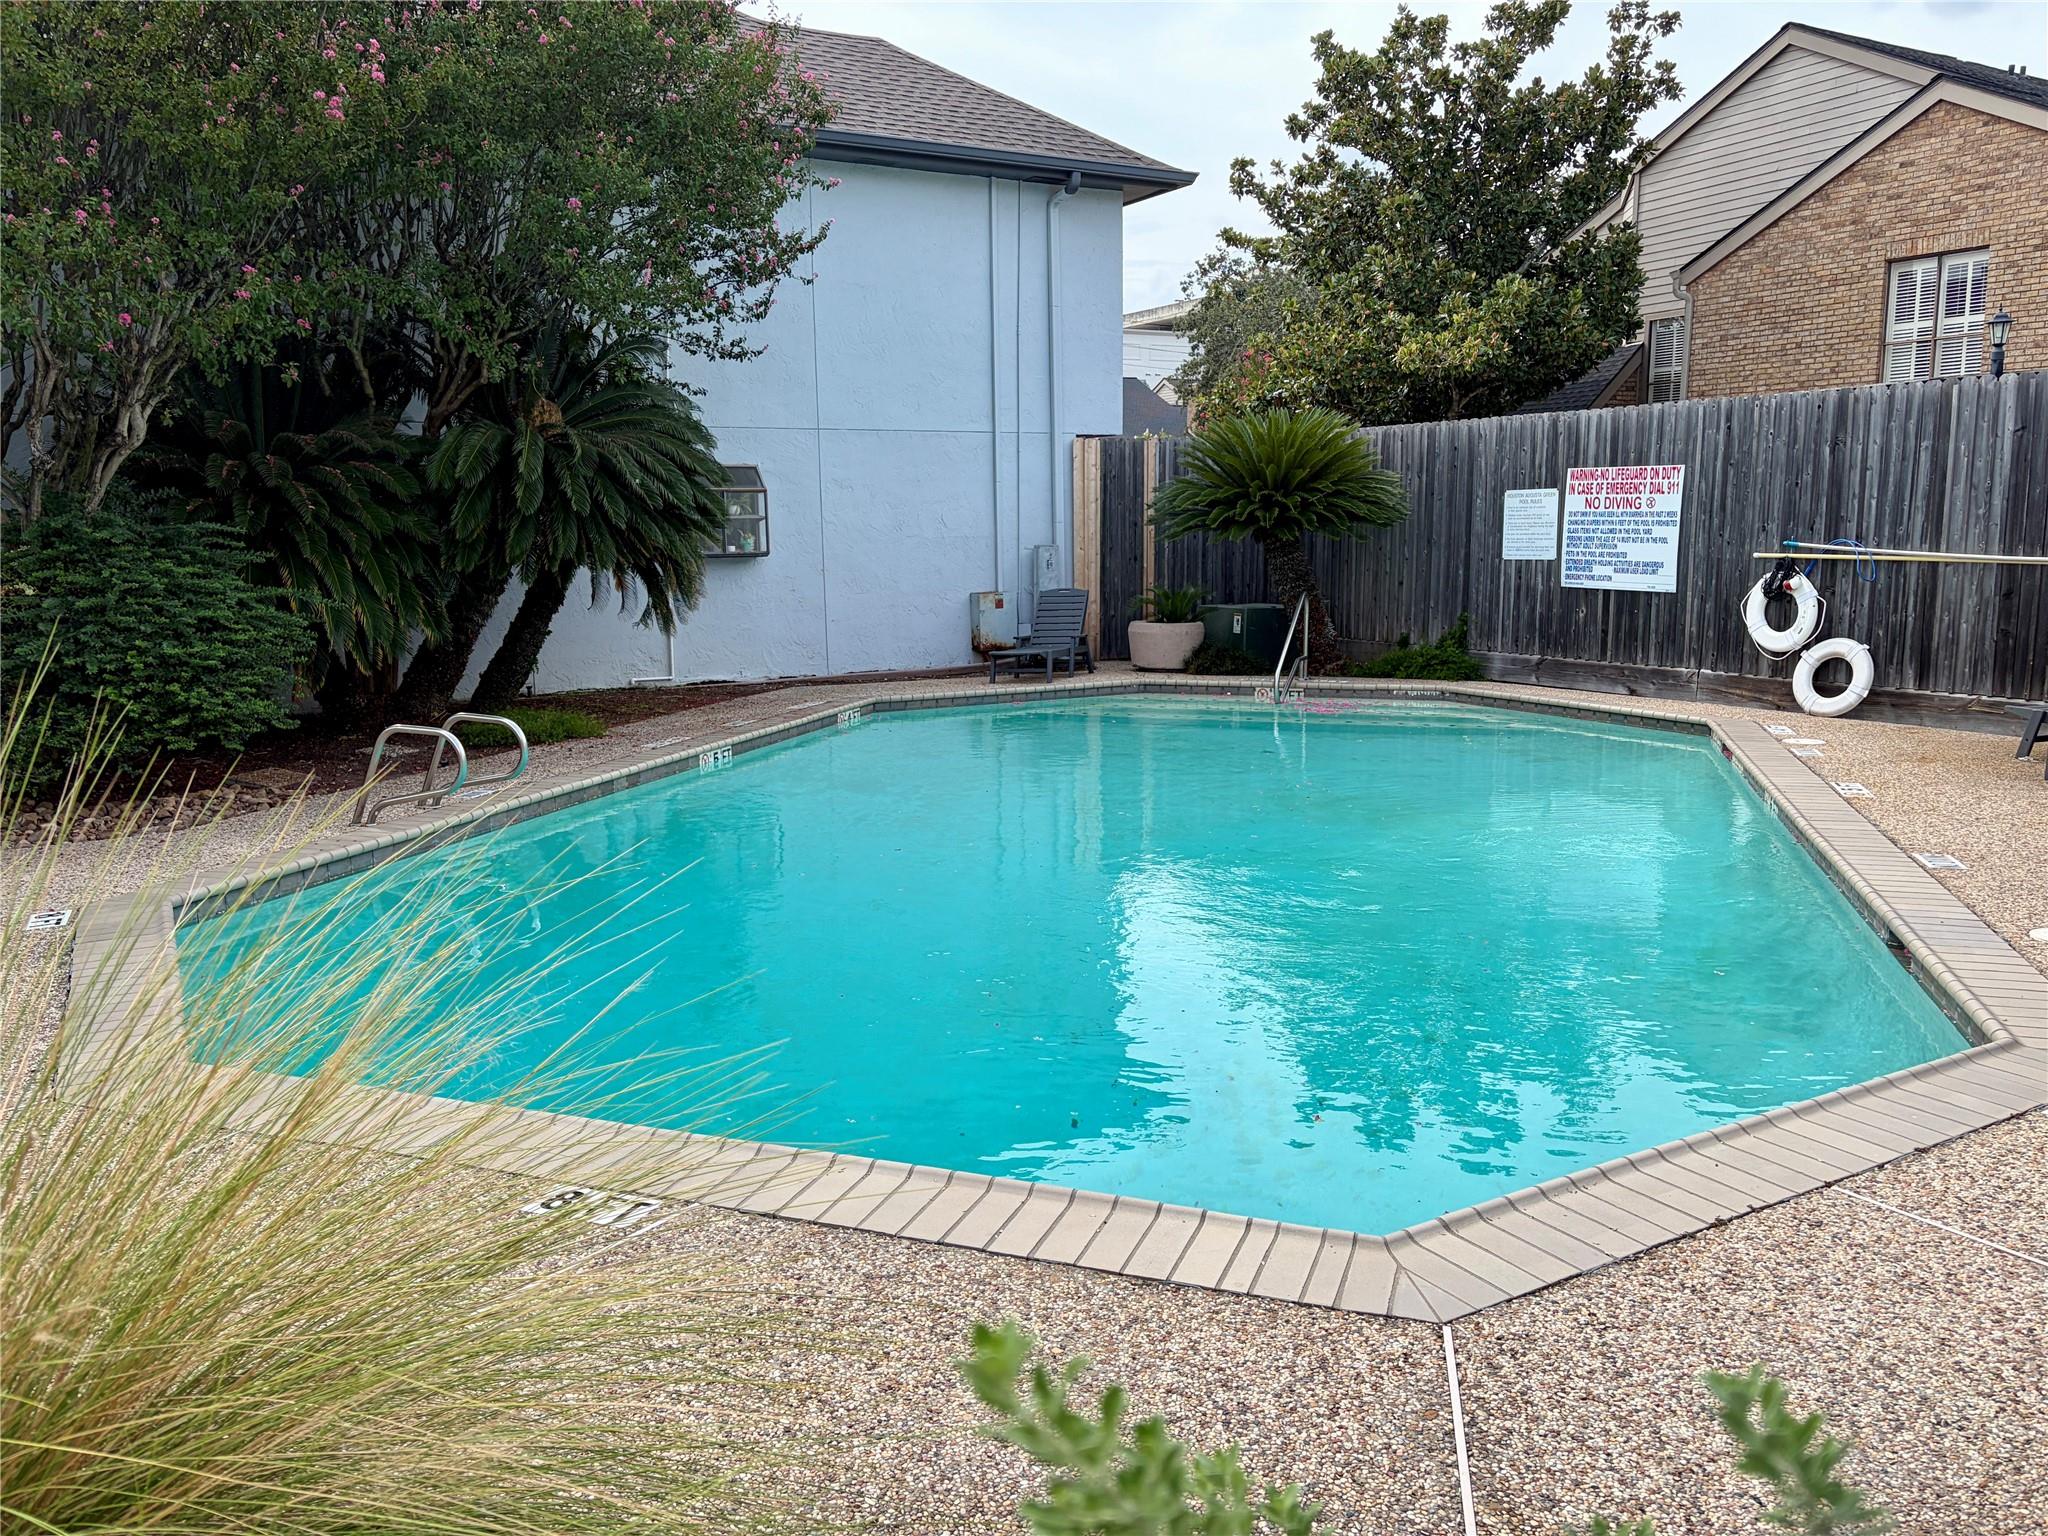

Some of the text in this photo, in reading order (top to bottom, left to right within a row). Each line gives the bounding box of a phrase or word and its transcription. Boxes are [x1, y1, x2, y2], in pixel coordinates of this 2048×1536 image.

[1570, 466, 1681, 481] WARNING-NO LIFEGUARD ON DUTY
[1569, 481, 1679, 495] IN CASE OF EMERGENCY DIAL 911
[1584, 496, 1642, 509] NO DIVING
